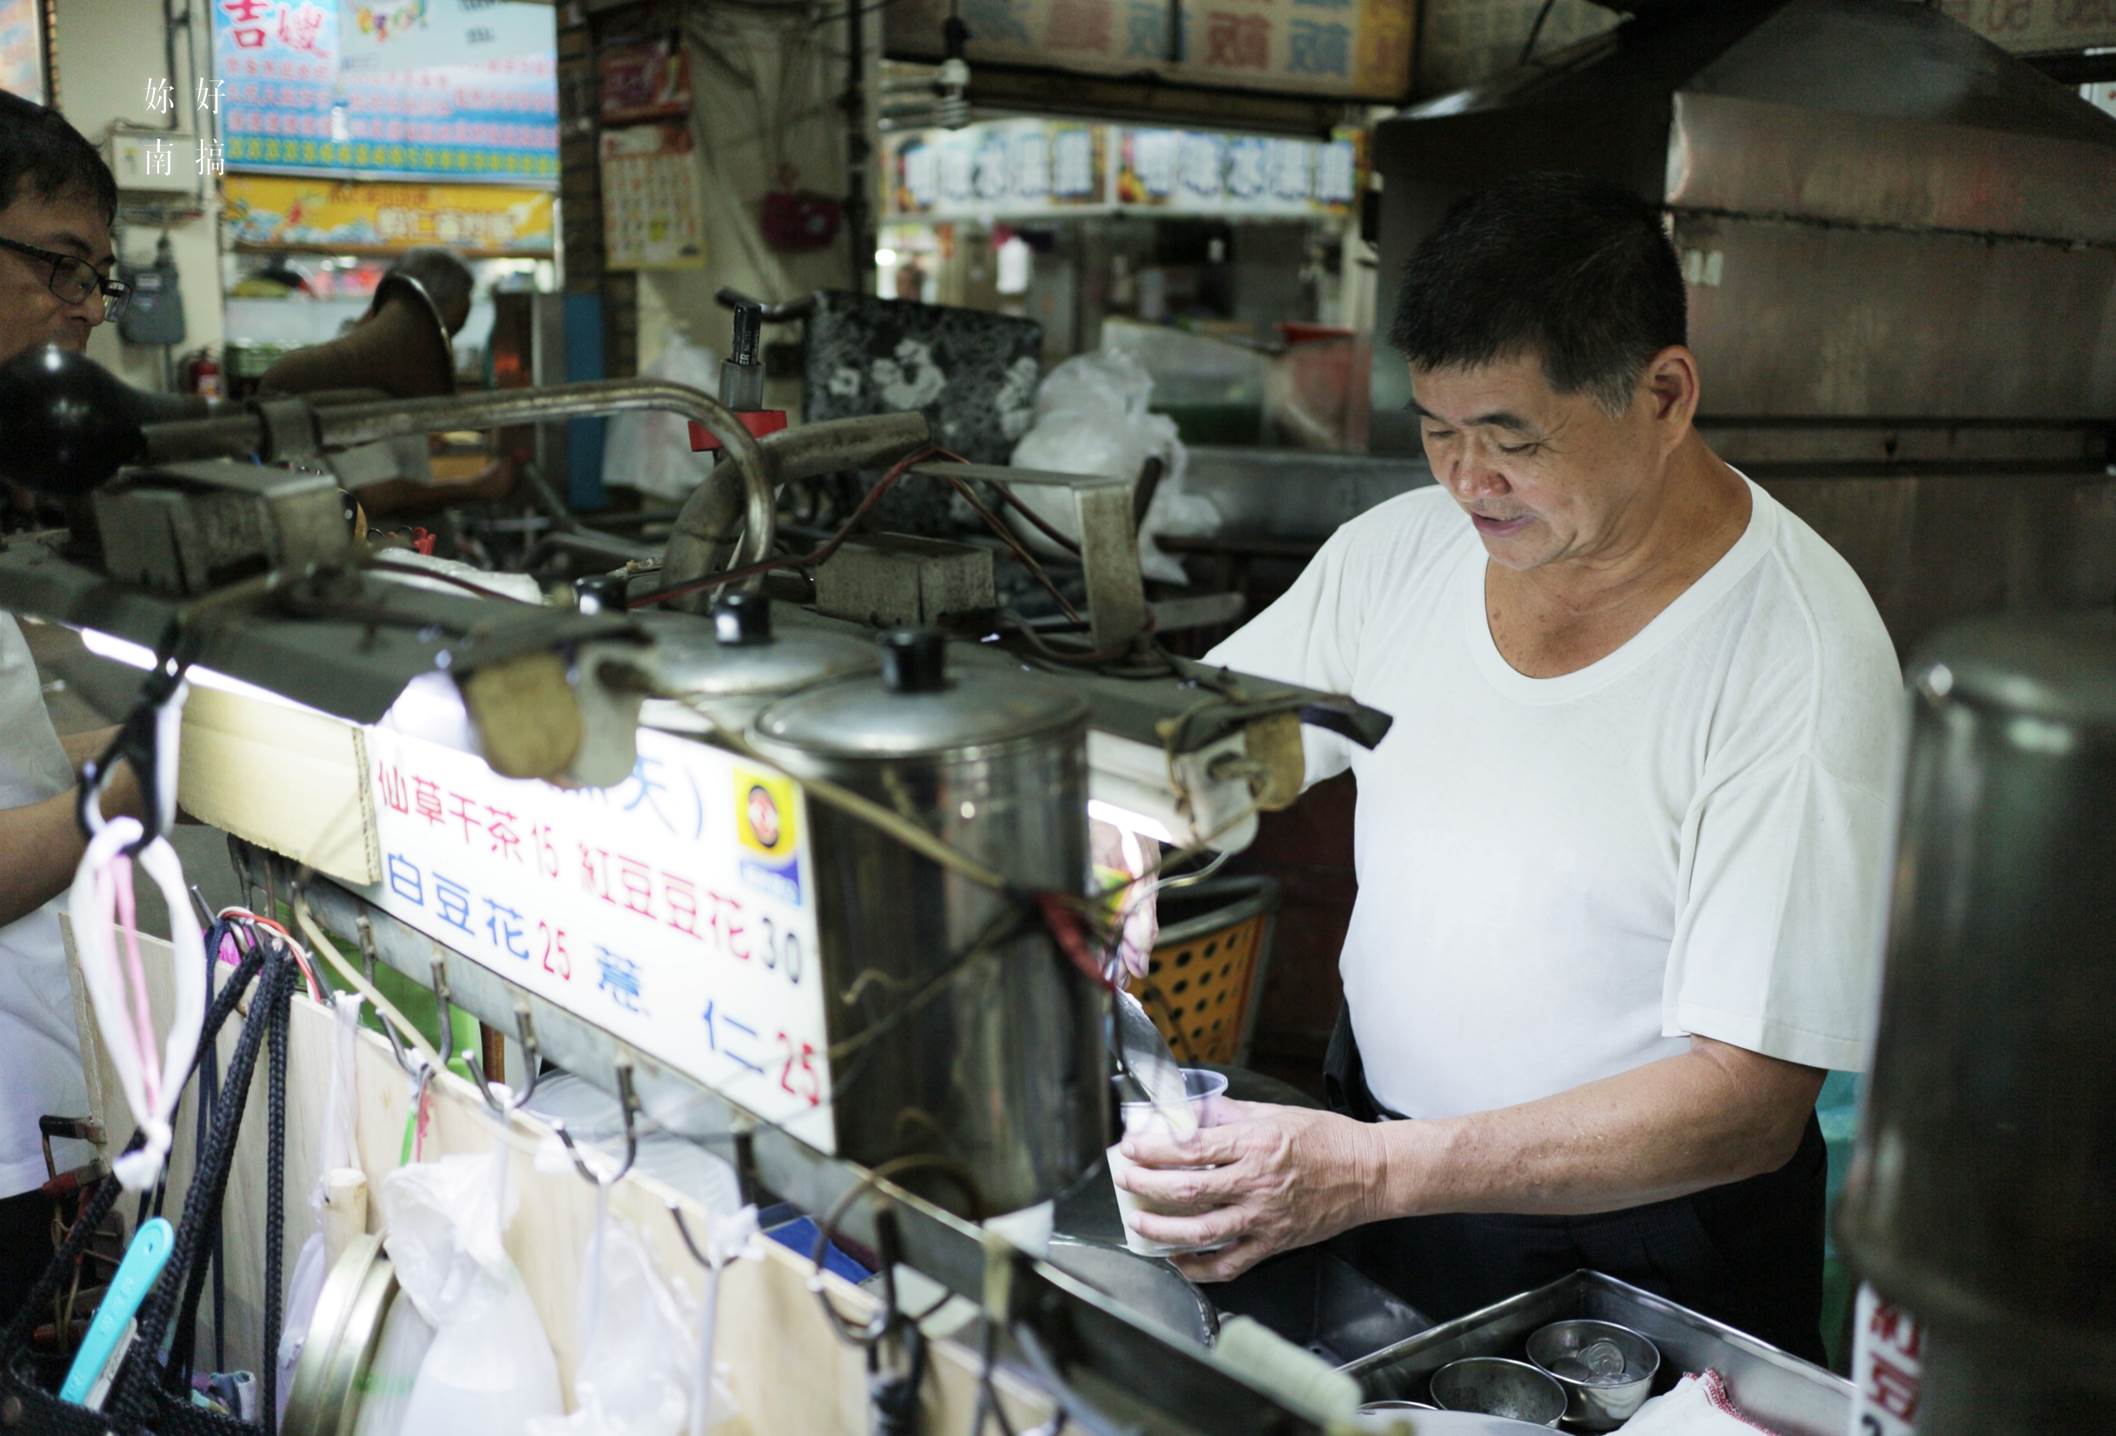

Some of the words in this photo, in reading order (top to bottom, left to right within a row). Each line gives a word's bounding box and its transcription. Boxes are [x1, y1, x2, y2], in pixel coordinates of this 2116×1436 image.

[387, 852, 531, 961] 白豆花
[537, 918, 572, 981] 25
[776, 1030, 821, 1107] 25
[579, 840, 751, 961] 紅豆豆花
[761, 914, 801, 984] 30
